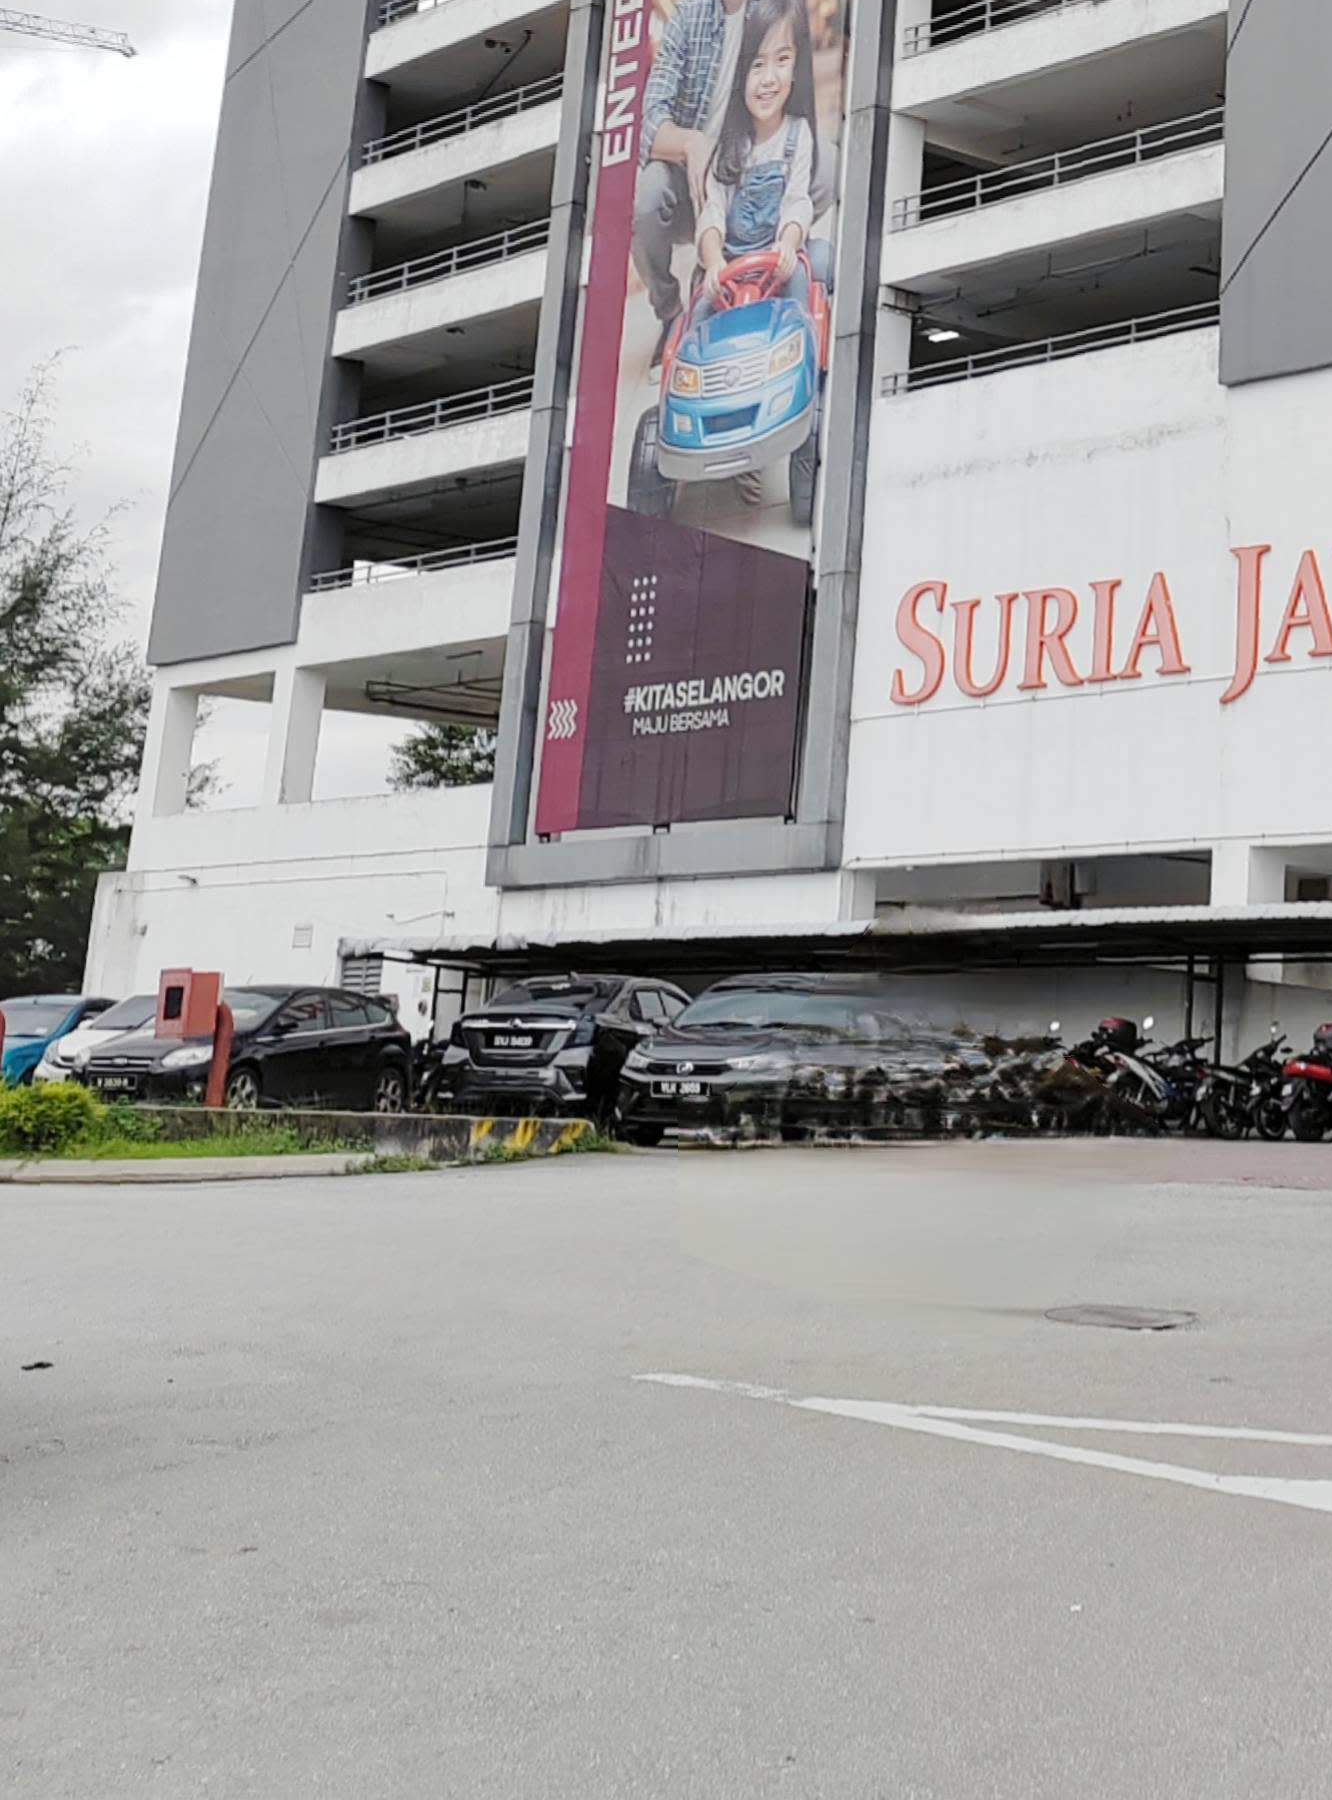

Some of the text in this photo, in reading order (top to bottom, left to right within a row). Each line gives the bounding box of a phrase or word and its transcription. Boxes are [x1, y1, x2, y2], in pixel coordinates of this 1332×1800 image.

[890, 571, 1192, 706] SURIA
[623, 669, 786, 714] #KITASELANGOR
[632, 708, 730, 736] MAJU BERSAMA
